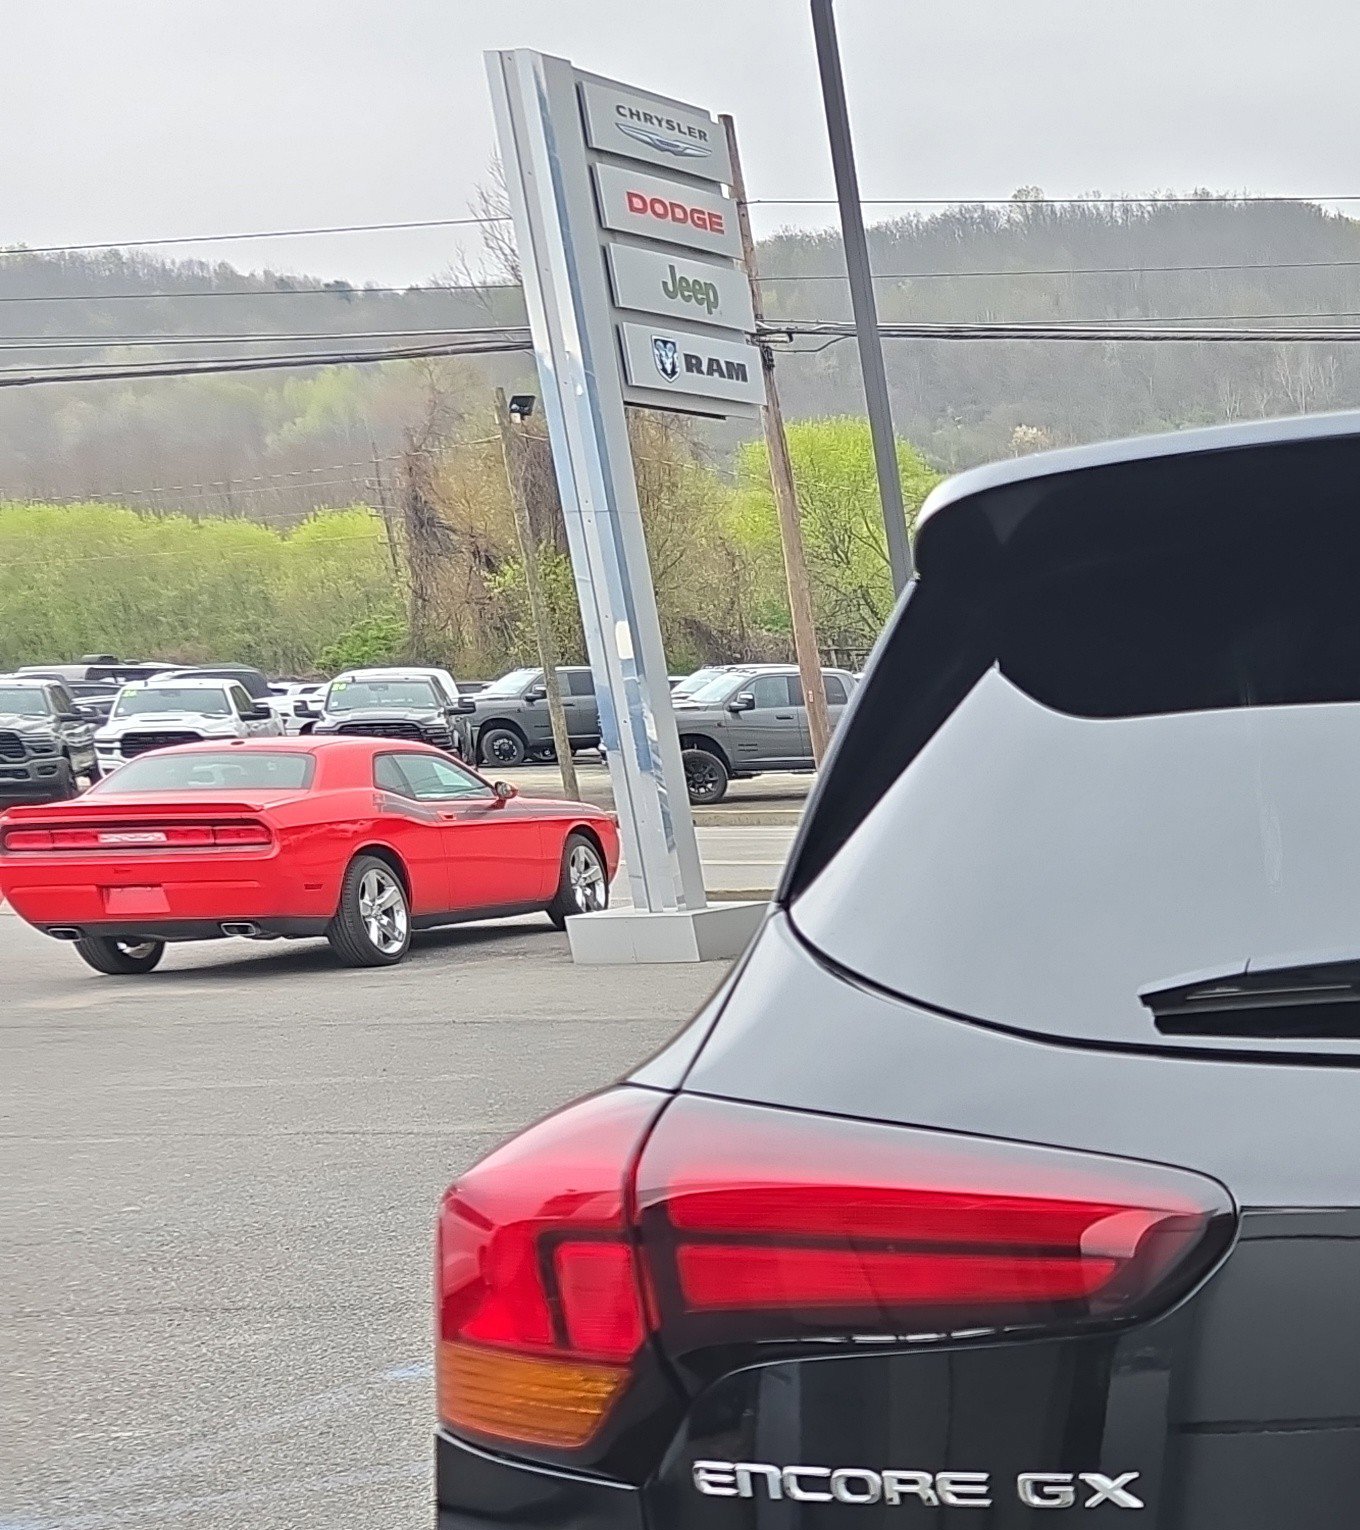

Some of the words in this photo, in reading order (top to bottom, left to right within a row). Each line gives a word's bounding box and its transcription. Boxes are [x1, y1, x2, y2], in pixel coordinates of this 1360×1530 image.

[615, 104, 708, 143] CHRYSLER
[625, 191, 725, 235] DODGE
[661, 264, 719, 315] Jeep
[684, 352, 748, 383] RAM
[692, 1459, 993, 1508] ENCORE
[1017, 1470, 1145, 1510] GX
